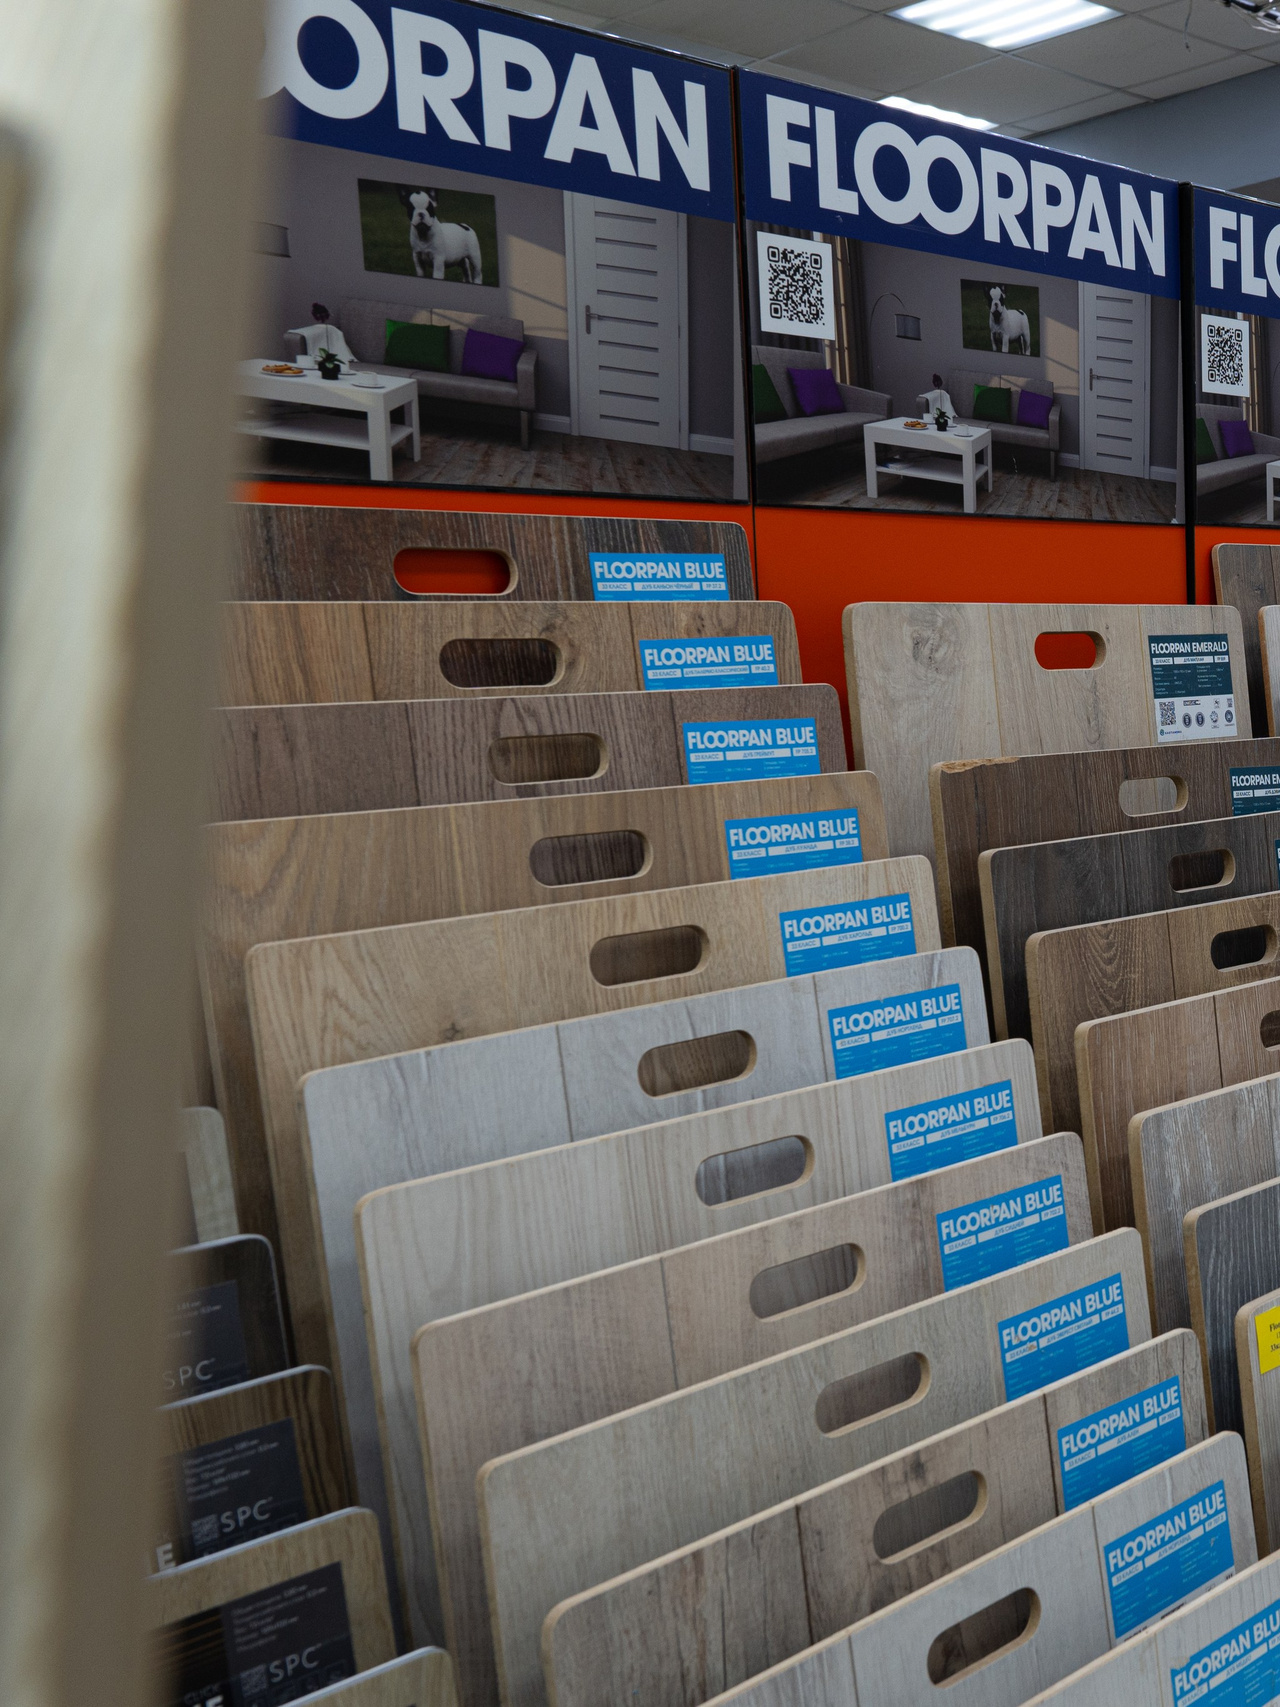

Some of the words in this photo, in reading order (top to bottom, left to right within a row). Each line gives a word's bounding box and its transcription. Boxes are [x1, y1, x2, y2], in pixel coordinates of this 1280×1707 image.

[258, 0, 710, 191] ORPAN
[766, 93, 1166, 277] FLOORPAN
[594, 561, 681, 578] FLOORPAN
[684, 562, 724, 578] BLUE
[644, 645, 730, 666] FLOORPAN
[733, 643, 773, 662] BLUE
[1150, 642, 1190, 653] FLOORPAN
[1191, 641, 1227, 652] EMERALD
[687, 728, 772, 749] FLOORPAN
[775, 726, 814, 744] BLUE
[1231, 774, 1270, 786] FLOORPAN
[729, 821, 815, 846] FLOORPAN
[818, 817, 857, 837] BLUE
[783, 908, 868, 938] FLOORPAN
[870, 901, 909, 924] BLUE
[832, 1001, 917, 1036] FLOORPAN
[920, 992, 960, 1016] BLUE
[888, 1100, 970, 1140] FLOORPAN
[973, 1089, 1011, 1115] BLUE
[941, 1197, 1022, 1240] FLOORPAN
[1024, 1183, 1062, 1212] BLUE
[1002, 1298, 1082, 1348] FLOORPAN
[1084, 1282, 1121, 1313] BLUE
[1061, 1403, 1140, 1457] FLOORPAN
[1142, 1385, 1179, 1418] BLUE
[220, 1500, 271, 1533] SPC
[1108, 1511, 1186, 1572] FLOORPAN
[1188, 1489, 1224, 1525] BLUE
[269, 1647, 319, 1684] SPC
[1174, 1629, 1250, 1698] FLOORPAN
